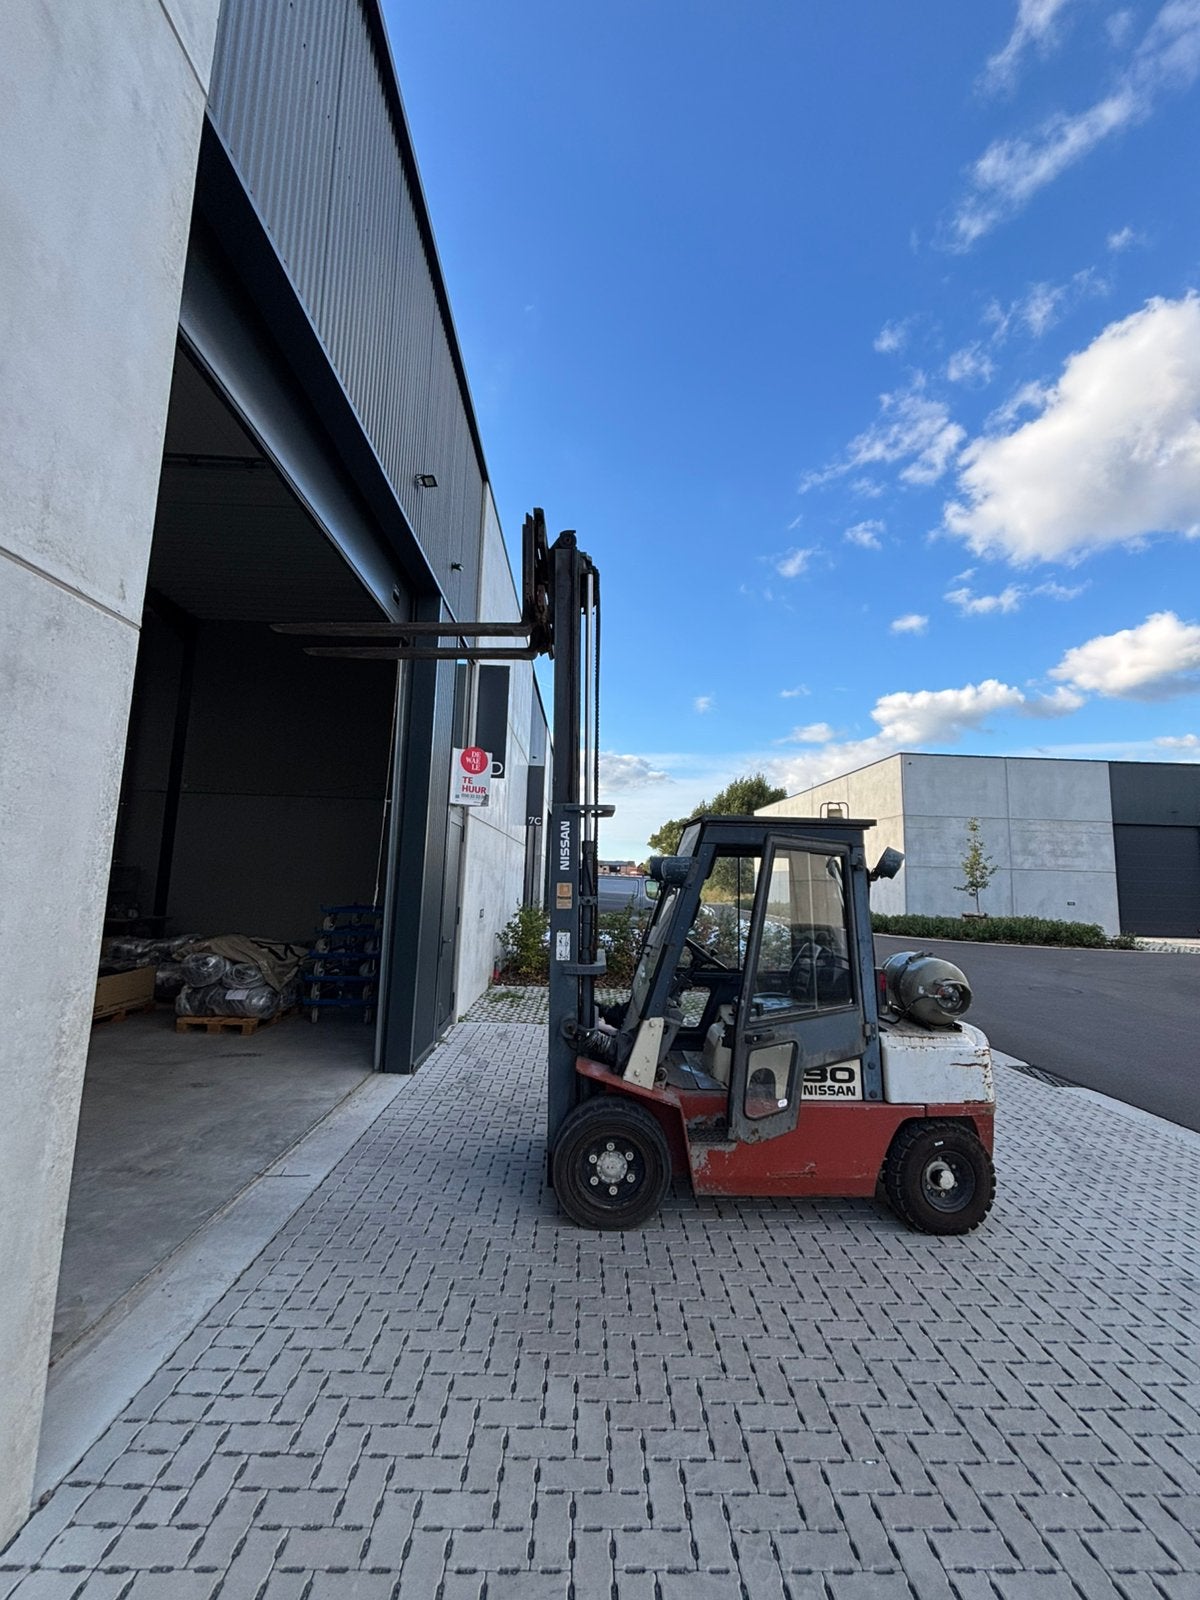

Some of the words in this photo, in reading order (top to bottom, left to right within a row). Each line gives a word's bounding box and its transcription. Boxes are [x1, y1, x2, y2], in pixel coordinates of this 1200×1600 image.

[463, 776, 473, 784] TE
[461, 785, 487, 794] HUUR
[528, 816, 542, 826] 7C
[560, 820, 570, 871] NISSAN
[803, 1067, 855, 1083] 30
[803, 1085, 856, 1096] NISSAN
